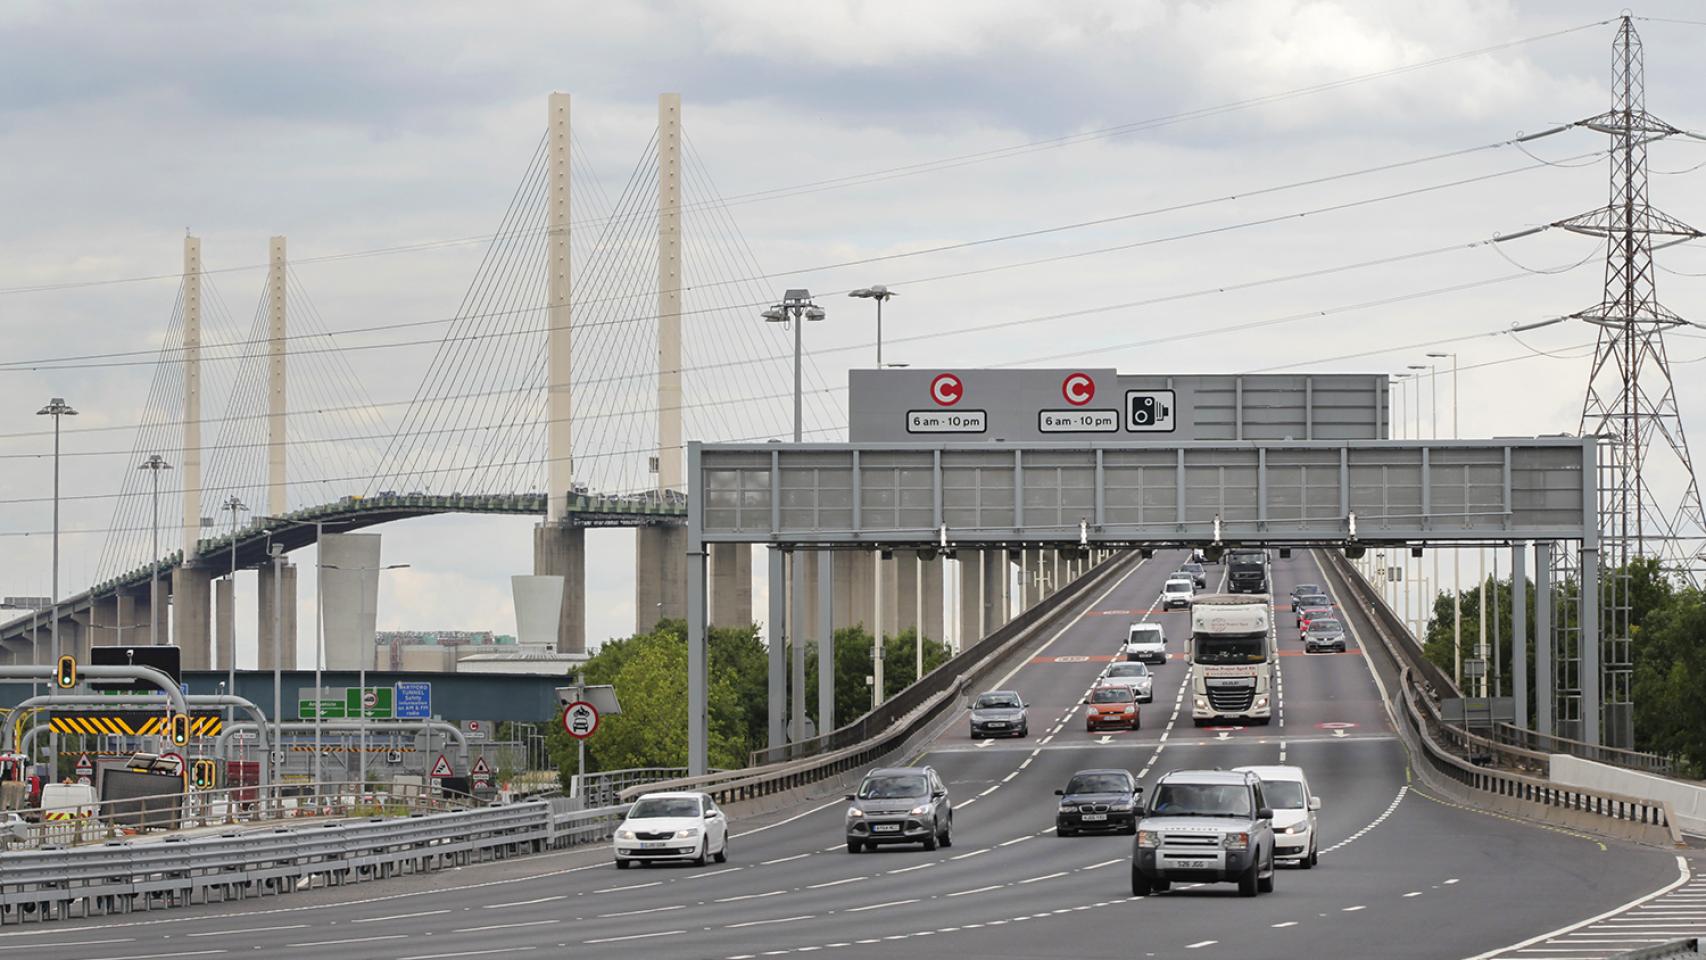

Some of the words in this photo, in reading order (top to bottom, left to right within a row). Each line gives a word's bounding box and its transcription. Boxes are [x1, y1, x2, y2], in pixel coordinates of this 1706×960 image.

[934, 377, 958, 402] C
[1066, 376, 1090, 402] C
[913, 416, 921, 426] 6
[923, 418, 939, 426] am
[948, 416, 961, 426] 10
[963, 418, 980, 427] pm
[1045, 416, 1053, 426] 6
[1055, 418, 1071, 426] am
[1080, 416, 1093, 426] 10
[1095, 418, 1112, 427] pm
